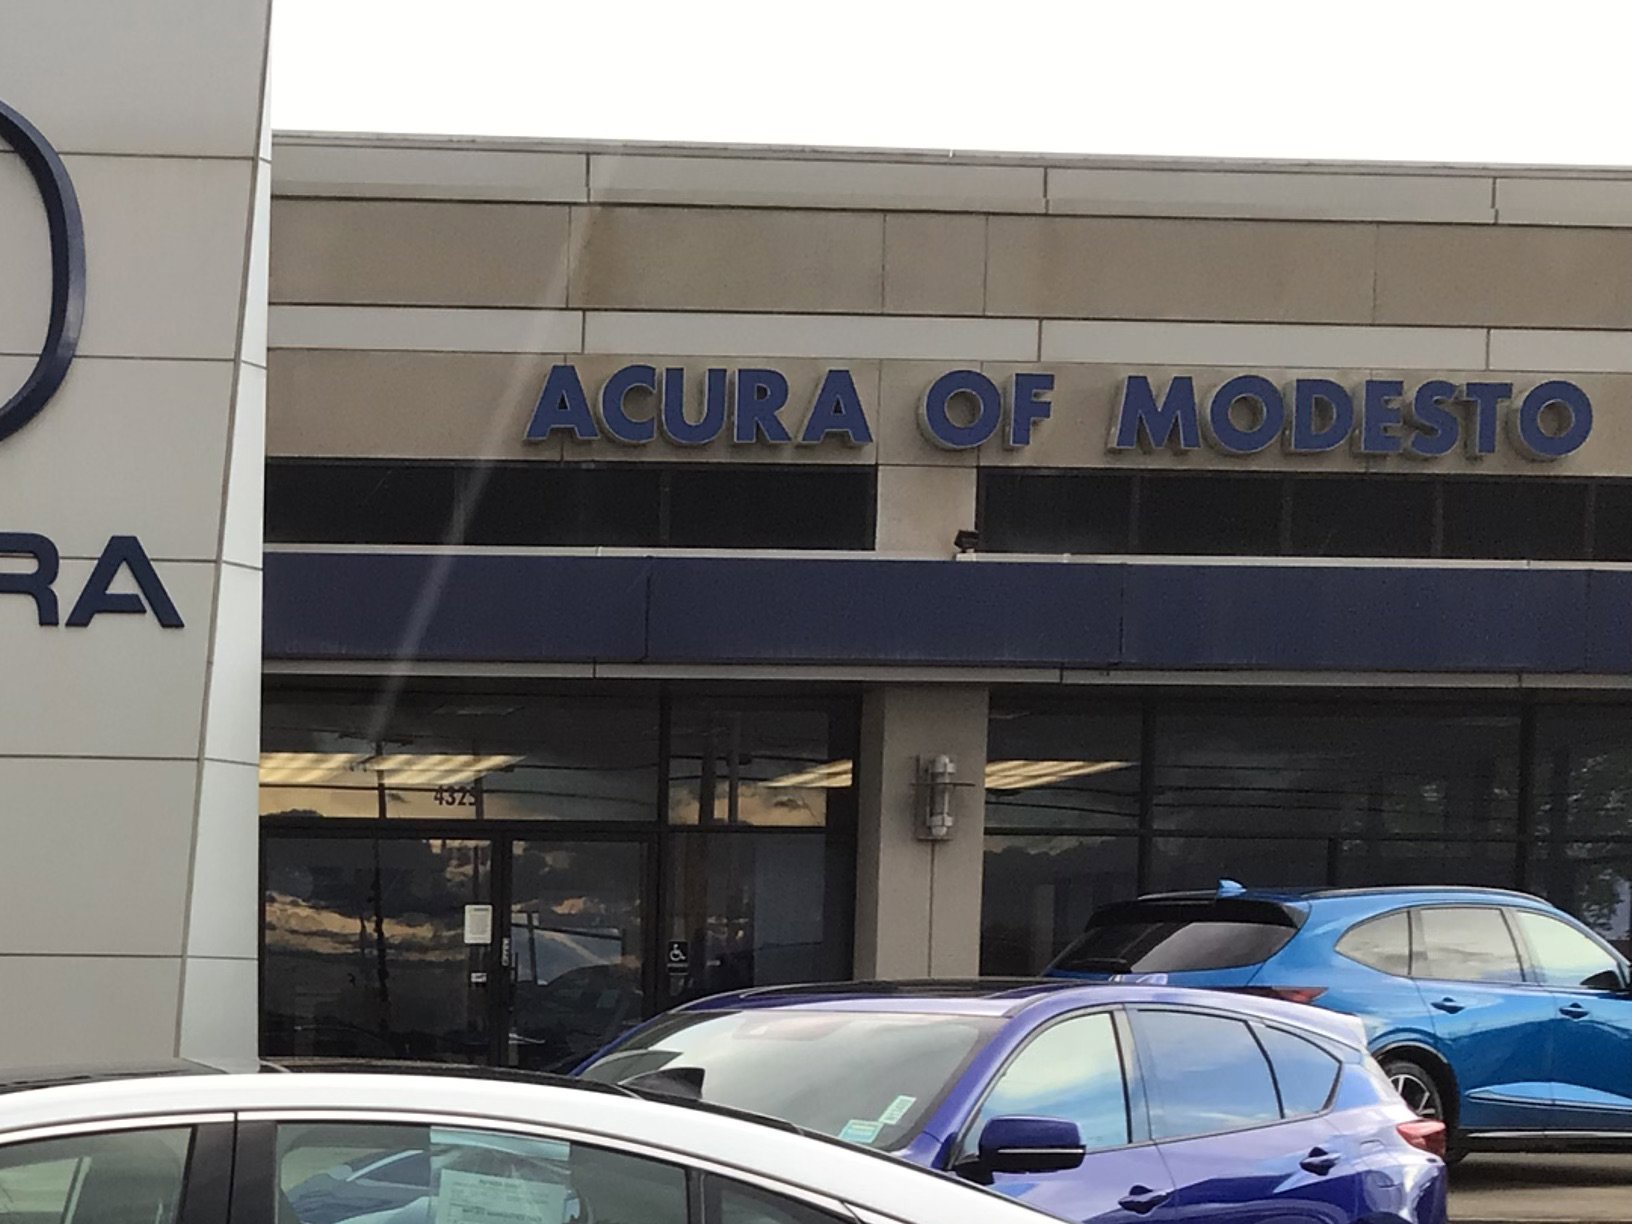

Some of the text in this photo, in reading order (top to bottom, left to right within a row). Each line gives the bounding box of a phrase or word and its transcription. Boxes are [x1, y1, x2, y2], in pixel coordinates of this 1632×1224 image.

[522, 363, 1594, 461] ACURA OF MODESTO
